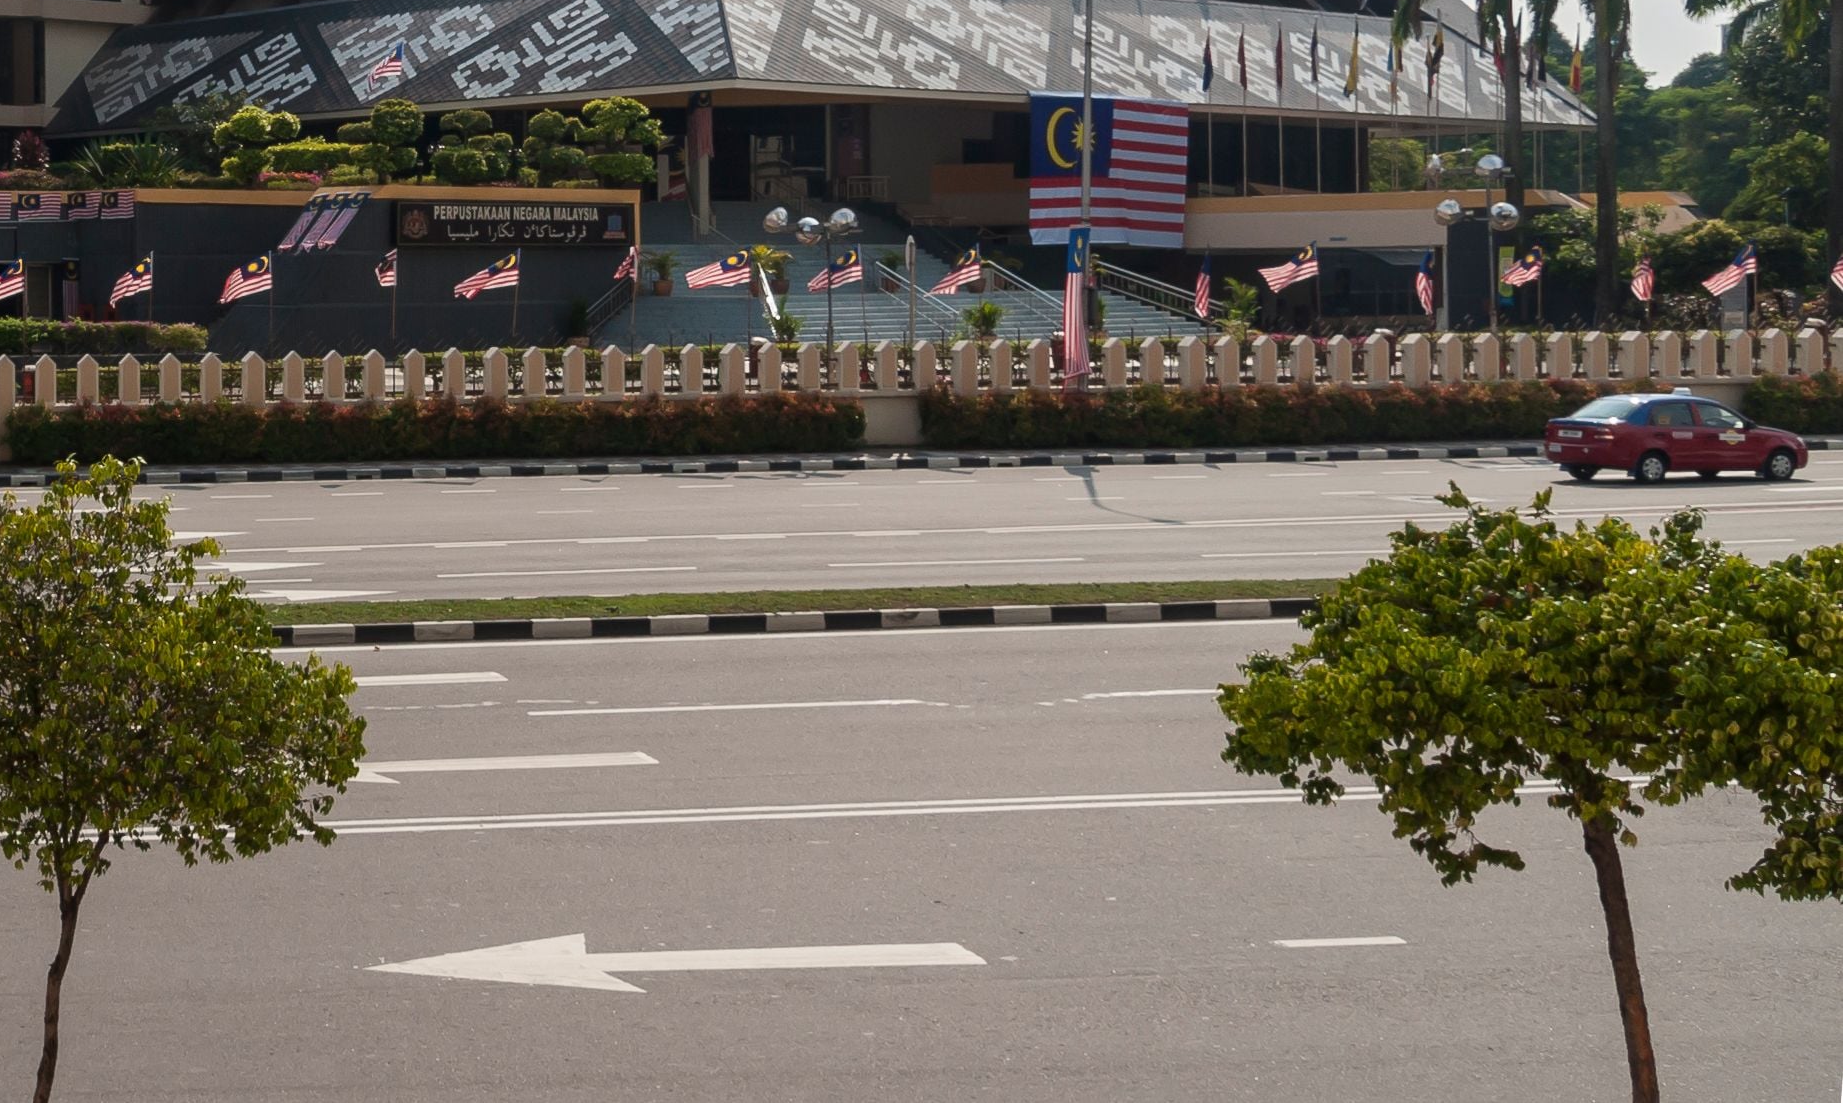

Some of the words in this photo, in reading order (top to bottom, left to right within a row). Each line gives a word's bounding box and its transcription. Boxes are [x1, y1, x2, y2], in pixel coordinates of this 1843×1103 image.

[434, 206, 511, 220] PERPUSTAKAAN
[513, 207, 551, 221] NEGARA
[553, 207, 599, 222] MALAYSIA
